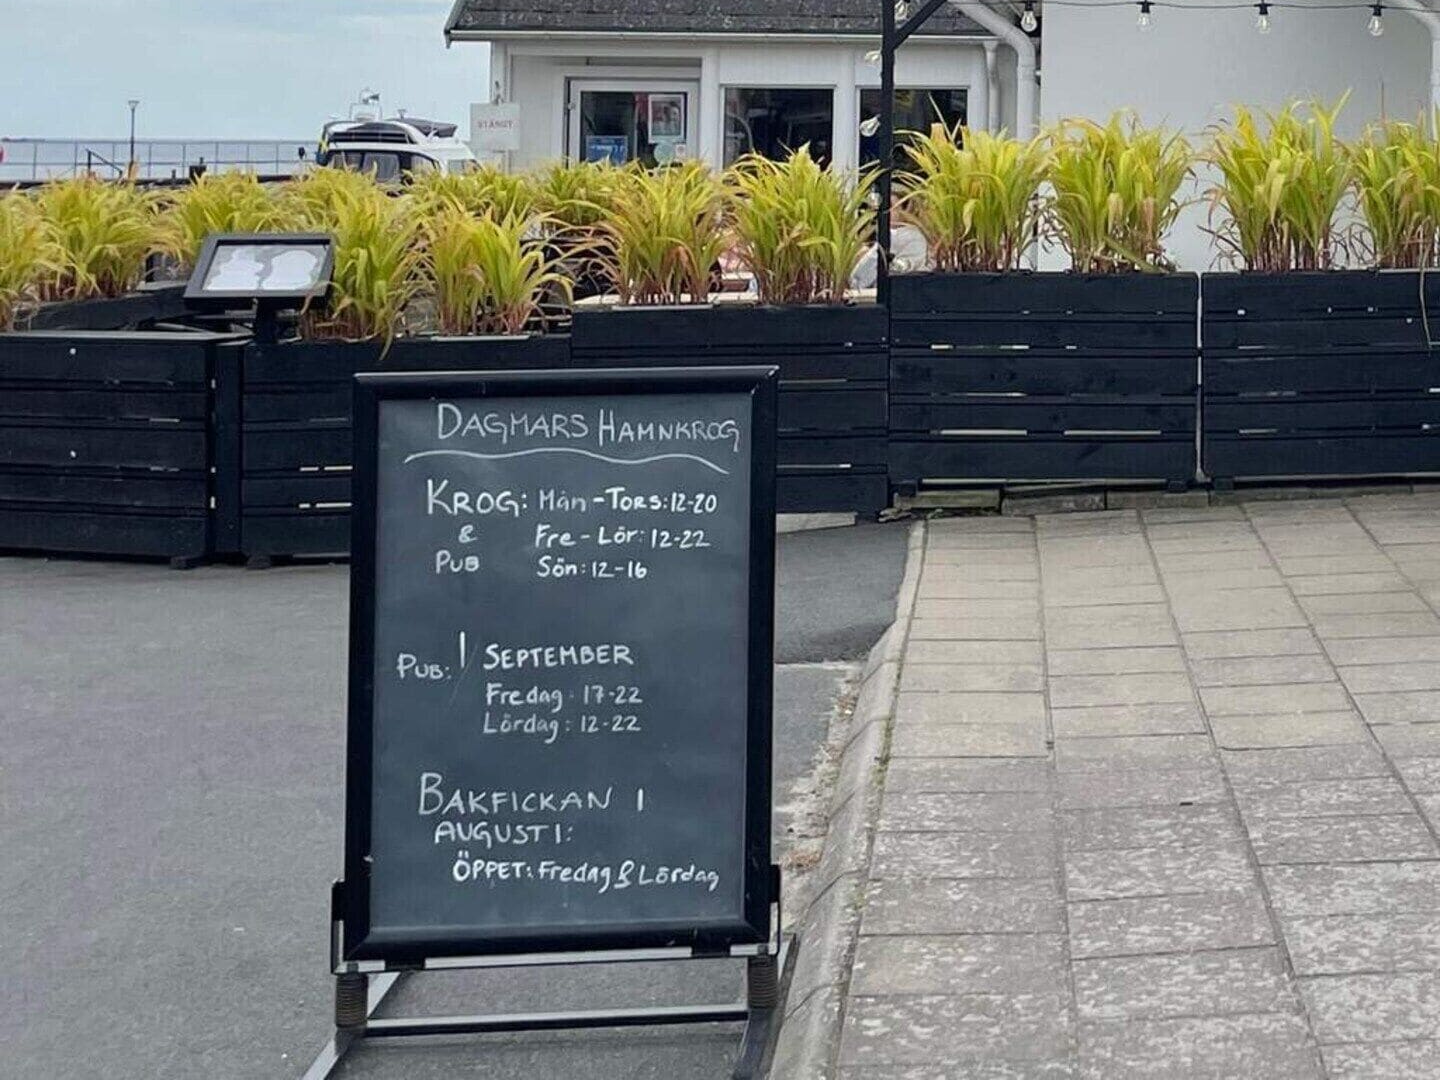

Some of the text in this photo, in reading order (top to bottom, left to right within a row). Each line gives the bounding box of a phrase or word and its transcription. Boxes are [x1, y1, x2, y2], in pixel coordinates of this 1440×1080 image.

[437, 403, 740, 452] DAGMARS HAMNKROG
[427, 479, 528, 517] KROG:
[539, 489, 586, 512] Mån
[458, 525, 477, 543] &
[535, 524, 577, 548] Fre
[651, 528, 711, 549] 12-22
[537, 555, 587, 578] Sön:
[592, 560, 648, 579] 12-16
[483, 643, 634, 670] SEPTEMBER
[584, 684, 643, 705] 17-22
[581, 714, 642, 733] 12-22
[418, 772, 613, 815] BAKFICKAN
[452, 850, 534, 882] ÖPPET:
[537, 861, 611, 893] Fredag
[638, 864, 719, 892] Lördag
